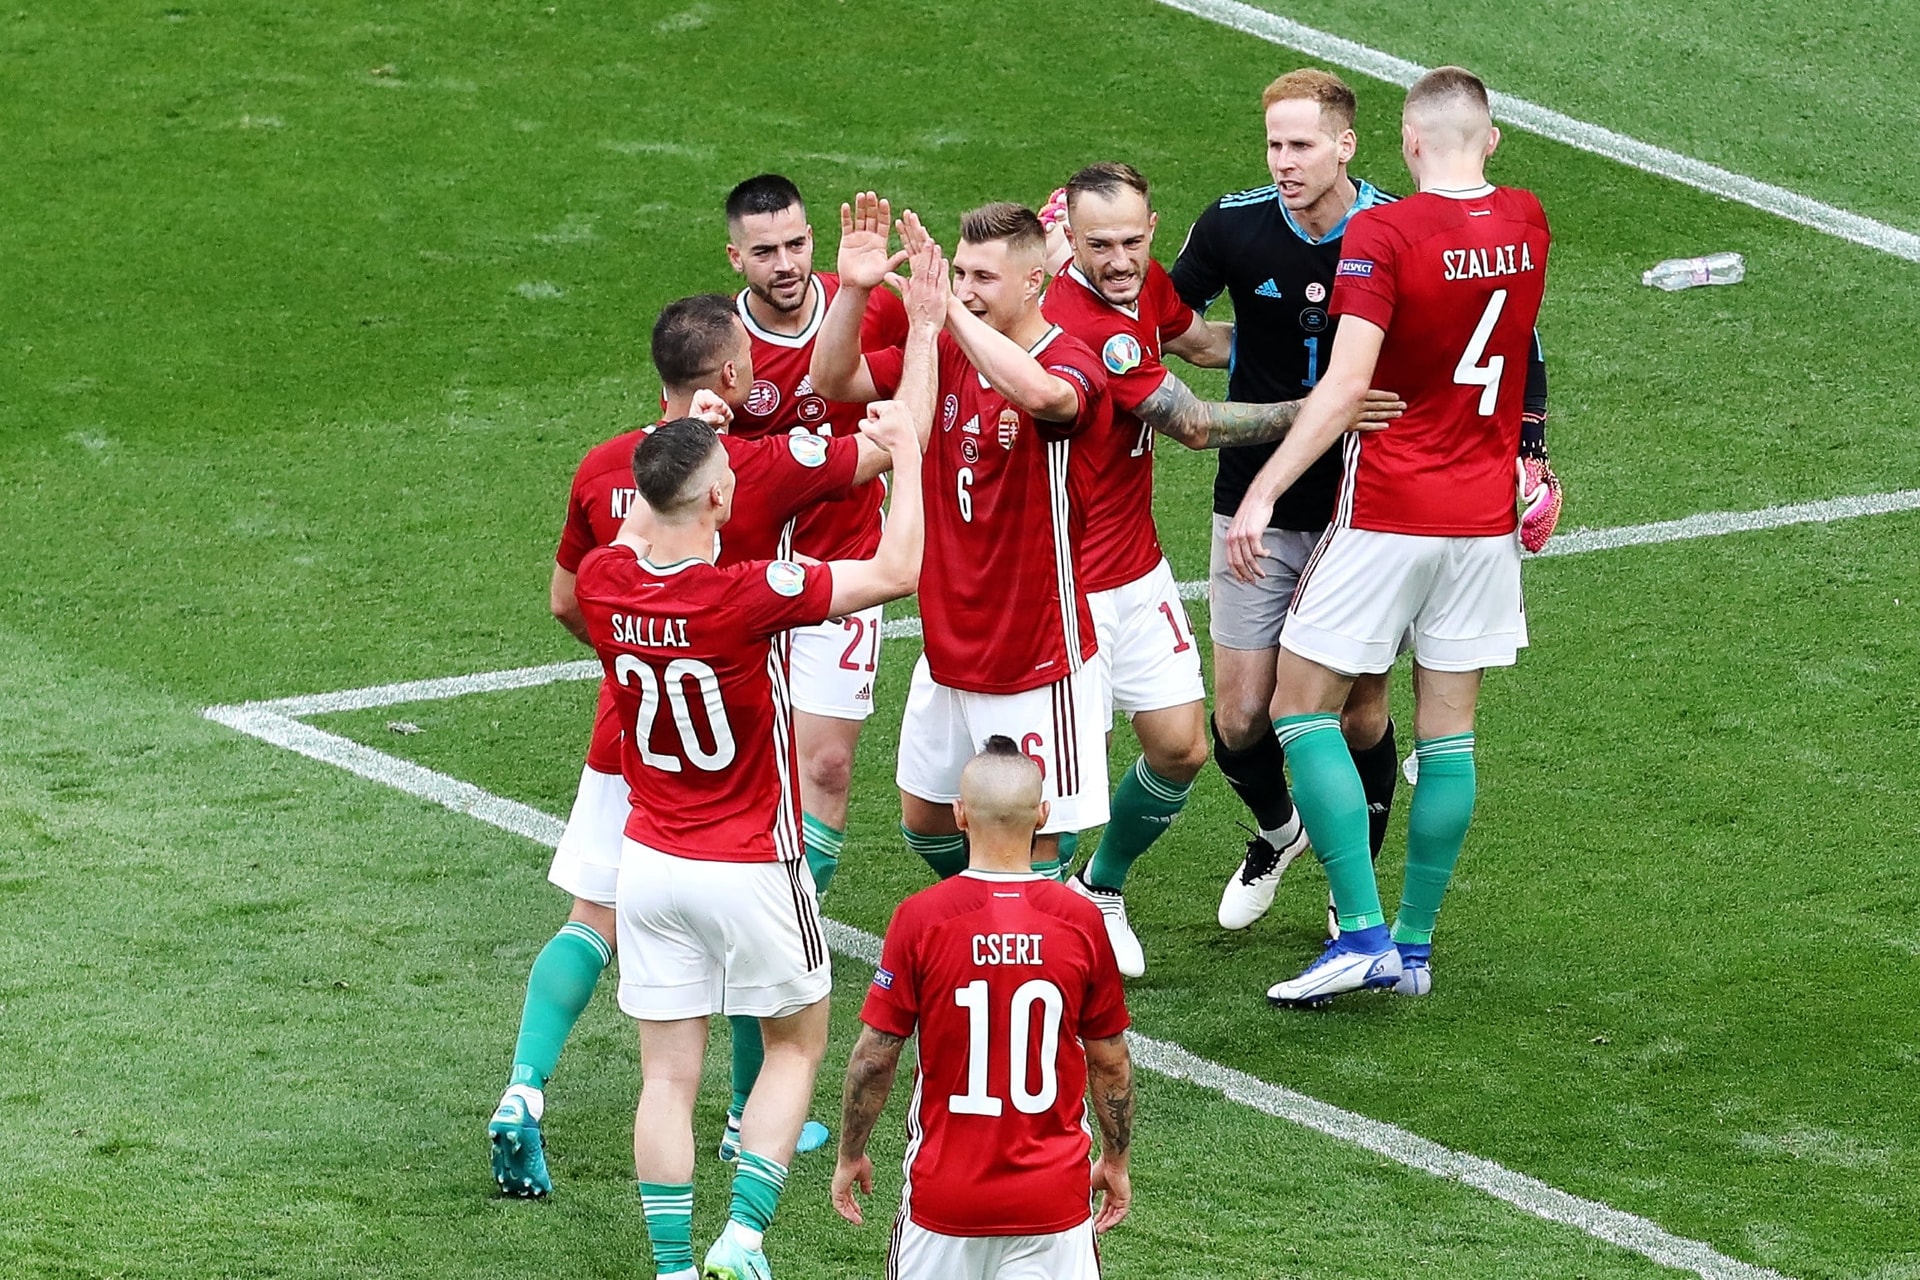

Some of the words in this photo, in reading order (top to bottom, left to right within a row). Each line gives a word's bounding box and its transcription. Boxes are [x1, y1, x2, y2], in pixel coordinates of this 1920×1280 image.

[1342, 262, 1373, 273] RESPECT
[1442, 244, 1518, 281] SZALAI
[1520, 241, 1535, 273] A.
[1254, 288, 1282, 298] adidas
[1301, 336, 1319, 388] 1
[1453, 289, 1507, 417] 4
[611, 487, 640, 519] NI
[957, 466, 974, 524] 6
[610, 613, 690, 648] SALLAI
[838, 616, 878, 673] 21
[614, 652, 737, 774] 20
[971, 932, 1044, 967] CSERI
[947, 978, 1065, 1118] 10
